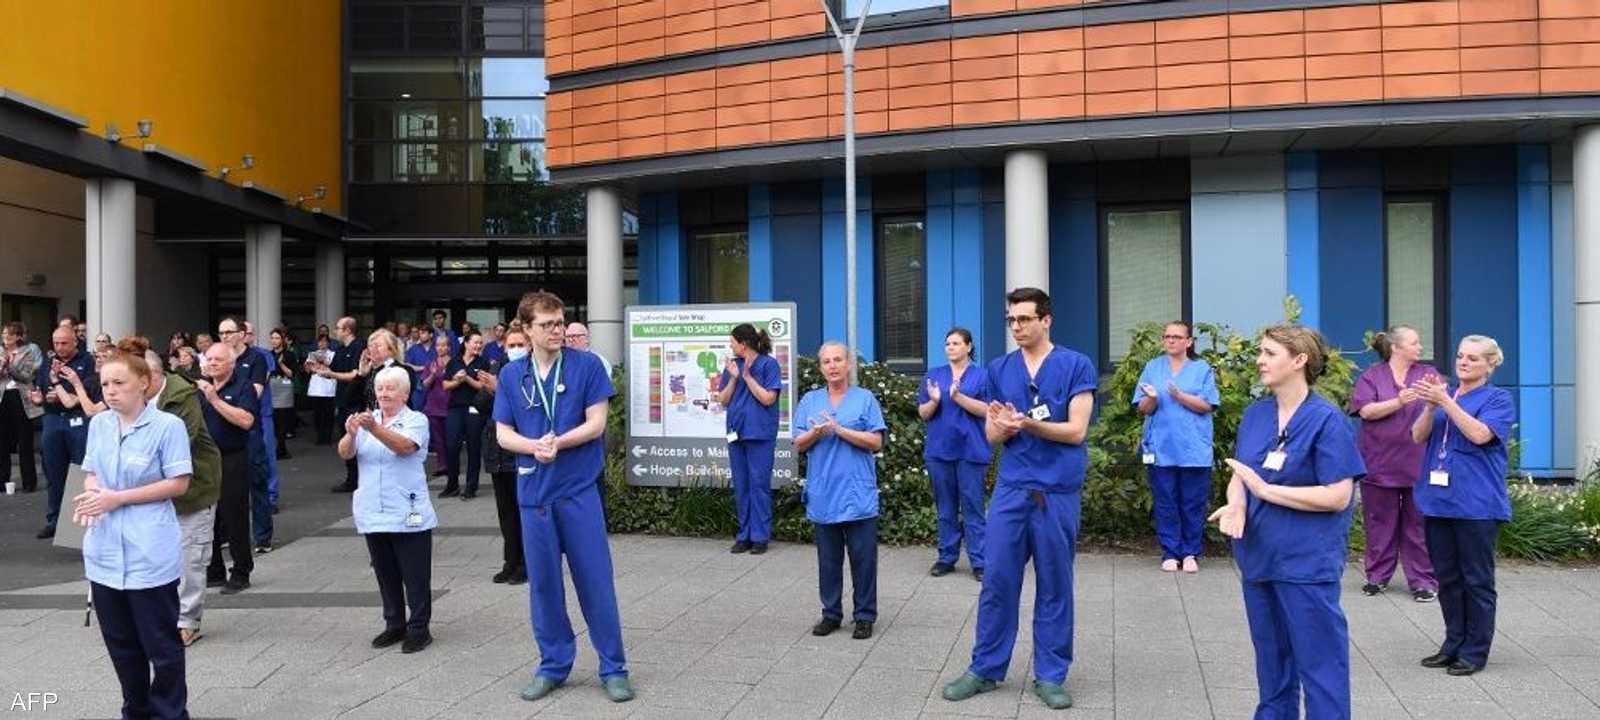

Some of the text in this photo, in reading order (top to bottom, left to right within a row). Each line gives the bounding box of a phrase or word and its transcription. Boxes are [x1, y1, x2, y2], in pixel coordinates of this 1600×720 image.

[643, 325, 681, 334] WELCOME
[683, 325, 694, 333] TO
[695, 324, 730, 333] SALFORD
[650, 445, 688, 458] Access
[692, 446, 704, 458] to
[650, 464, 681, 477] Hope
